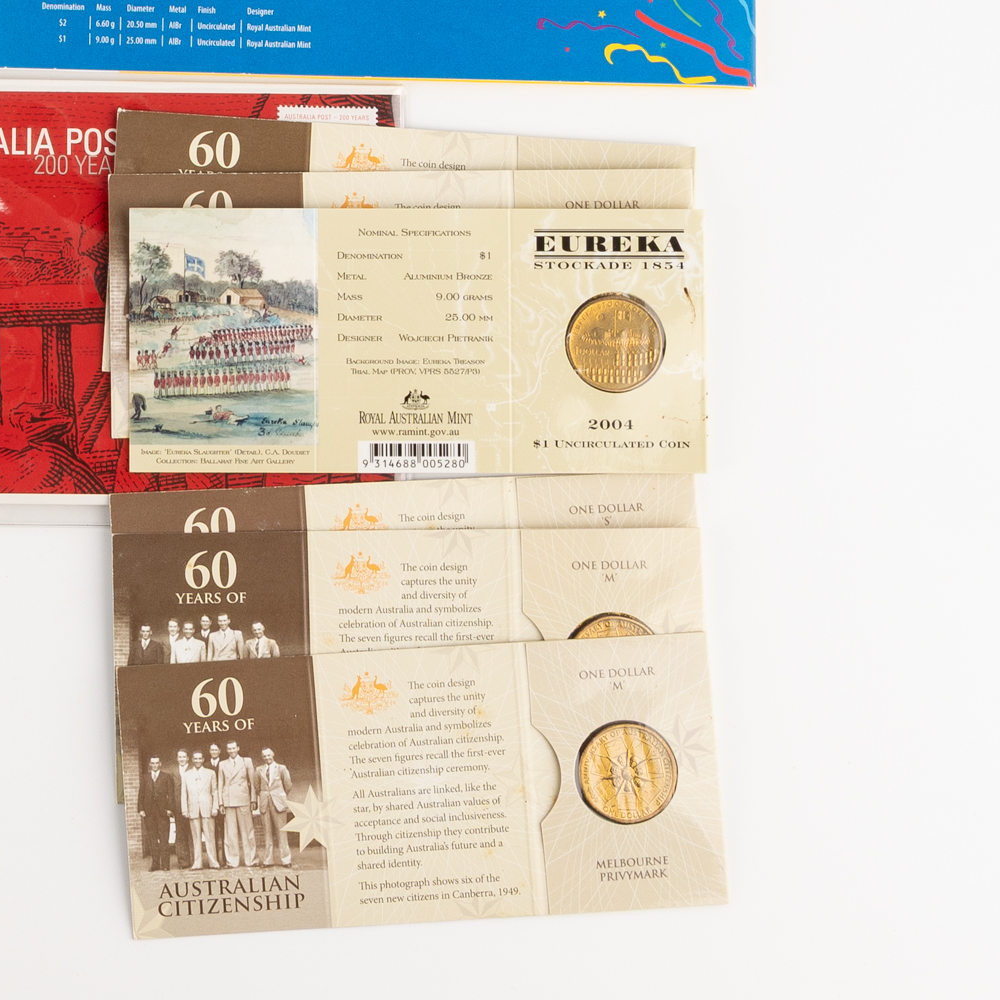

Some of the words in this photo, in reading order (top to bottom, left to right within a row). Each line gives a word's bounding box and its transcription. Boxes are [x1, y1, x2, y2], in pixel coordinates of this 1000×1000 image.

[41, 2, 85, 11] Denomination
[96, 3, 112, 12] Mass
[126, 3, 155, 13] Diameter
[169, 5, 187, 14] Metal
[197, 6, 216, 15] Finish
[247, 7, 274, 17] Designer
[66, 127, 117, 156] POS
[188, 130, 241, 169] 60
[34, 154, 68, 175] 200
[74, 155, 112, 175] YEA
[536, 235, 683, 253] EUREKA
[533, 261, 632, 270] STOCKADE
[643, 261, 684, 270] 1854
[588, 419, 632, 430] 2004
[371, 428, 460, 439] www.ramint.gov.au
[578, 669, 605, 680] ONE
[608, 666, 656, 678] DOLLAR
[407, 680, 425, 690] The
[426, 681, 446, 689] coin
[447, 678, 476, 690] design
[191, 676, 244, 718] 60
[183, 719, 230, 734] YEARS
[234, 718, 255, 731] OF
[348, 740, 397, 751] celebration
[397, 737, 408, 748] of
[409, 735, 454, 747] Australian
[455, 732, 505, 745] citizenship.
[596, 855, 668, 869] MELBOURNE
[600, 868, 668, 882] PRIVYMARK
[159, 874, 301, 899] AUSTRALIAN
[359, 896, 384, 905] seven
[386, 895, 405, 903] new
[406, 893, 440, 902] citizens
[441, 892, 451, 900] in
[452, 888, 496, 899] Canberra,
[498, 886, 521, 897] 1949.
[158, 892, 306, 918] CITIZENSHIP
